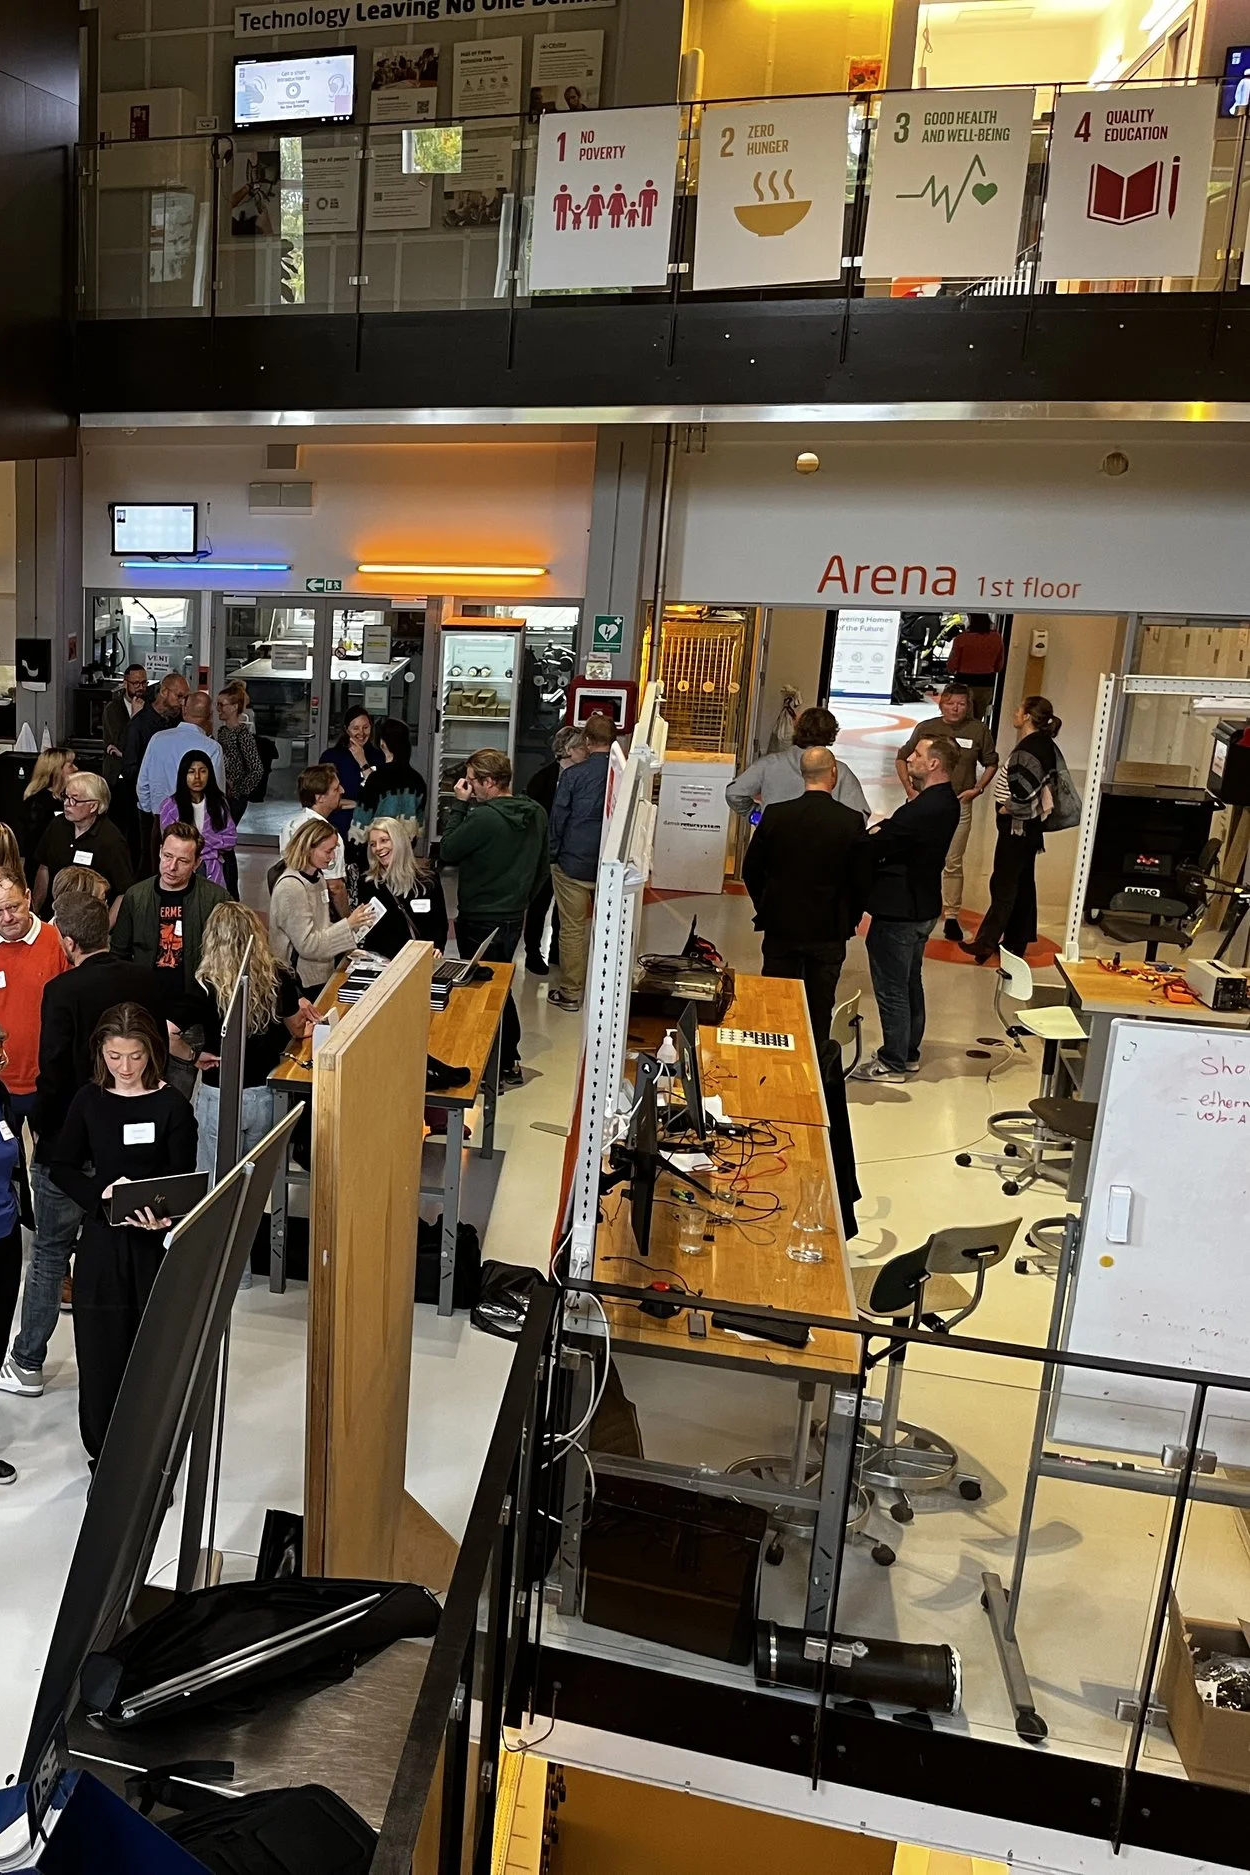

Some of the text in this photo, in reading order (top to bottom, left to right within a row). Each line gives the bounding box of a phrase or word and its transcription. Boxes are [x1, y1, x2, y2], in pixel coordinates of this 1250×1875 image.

[239, 7, 350, 31] Technology
[356, 0, 440, 21] Leaving
[446, 0, 475, 14] No
[924, 110, 998, 126] GOOD HEALTH
[1106, 109, 1154, 126] QUALITY
[748, 124, 775, 139] ZERO
[894, 112, 911, 143] 3
[921, 127, 1010, 143] AND WELL-BEING
[1074, 112, 1091, 143] 4
[1104, 126, 1168, 143] EDUCATION
[580, 131, 595, 144] NO
[720, 127, 735, 158] 2
[557, 132, 567, 161] 1
[579, 145, 626, 161] POVERTY
[746, 139, 789, 156] HUNGER
[817, 554, 1082, 599] Arena 1st floor
[838, 616, 864, 624] wering
[1200, 1056, 1250, 1076] Sho
